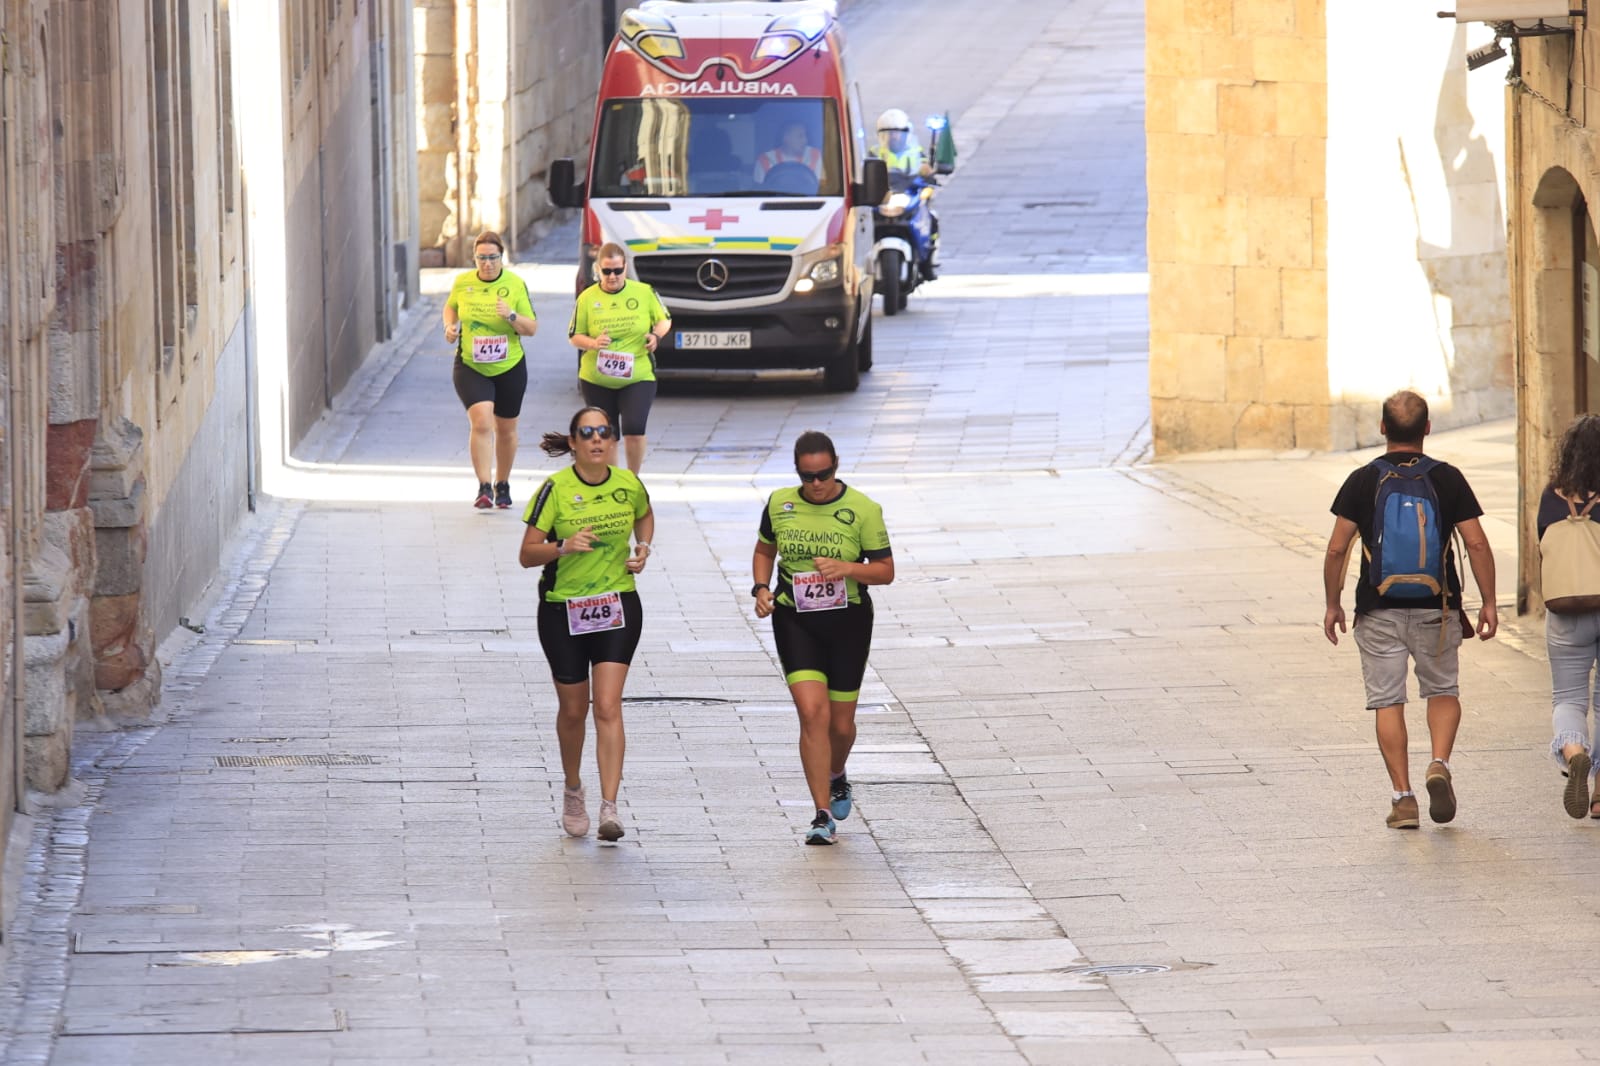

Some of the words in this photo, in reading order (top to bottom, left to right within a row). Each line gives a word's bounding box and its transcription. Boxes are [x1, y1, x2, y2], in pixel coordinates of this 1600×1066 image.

[684, 334, 718, 347] 3710
[723, 334, 748, 347] JKR
[480, 344, 502, 355] 414
[604, 359, 626, 371] 498
[579, 520, 629, 533] CRBAJOSA
[779, 543, 842, 560] CARBAJOSA
[805, 582, 836, 599] 428
[580, 605, 612, 621] 448
